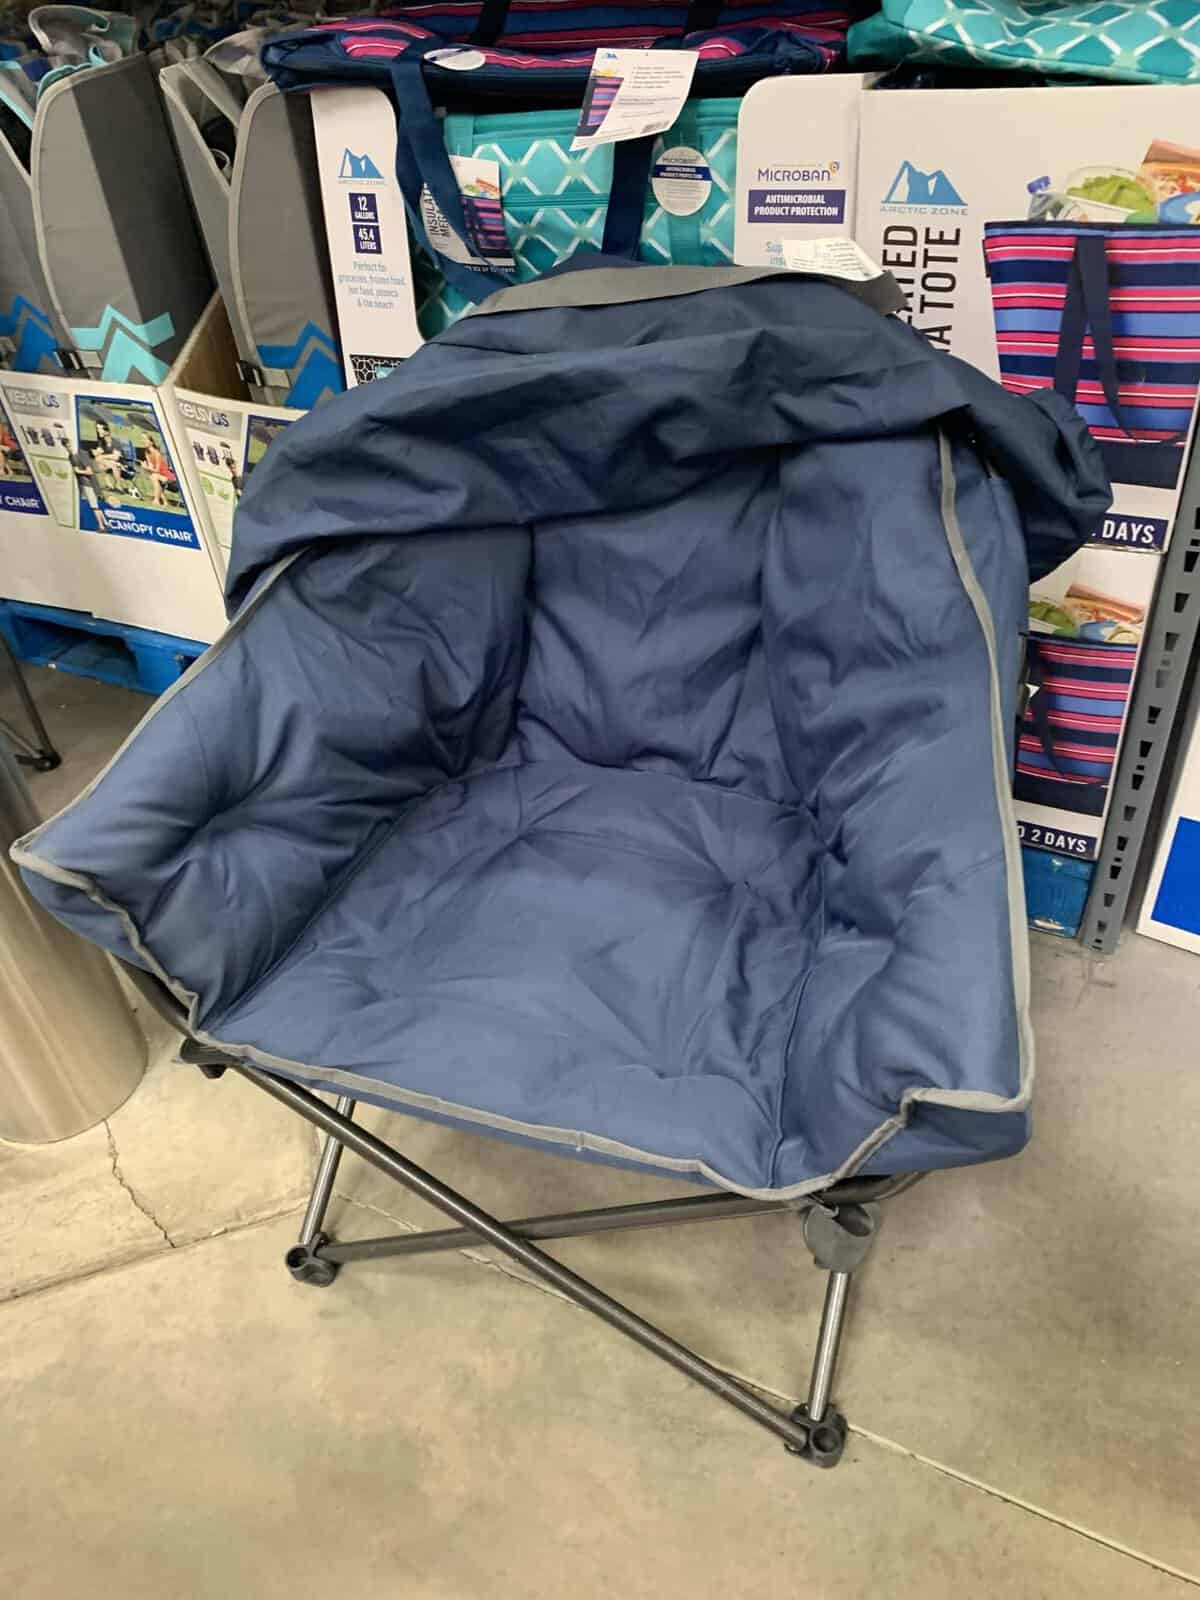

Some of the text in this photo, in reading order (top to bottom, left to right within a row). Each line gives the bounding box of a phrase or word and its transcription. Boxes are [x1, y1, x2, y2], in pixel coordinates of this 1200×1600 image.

[357, 195, 369, 211] 12
[765, 194, 826, 204] ANTIMICROBIAL
[754, 206, 839, 217] PRODUCT PROTECTION
[880, 206, 969, 216] ARCTIC ZONE
[919, 227, 961, 314] TOTE
[108, 519, 193, 542] CANOPY CHAIR
[1102, 519, 1155, 544] DAYS
[1031, 828, 1041, 842] 2
[1044, 832, 1087, 853] DAYS
